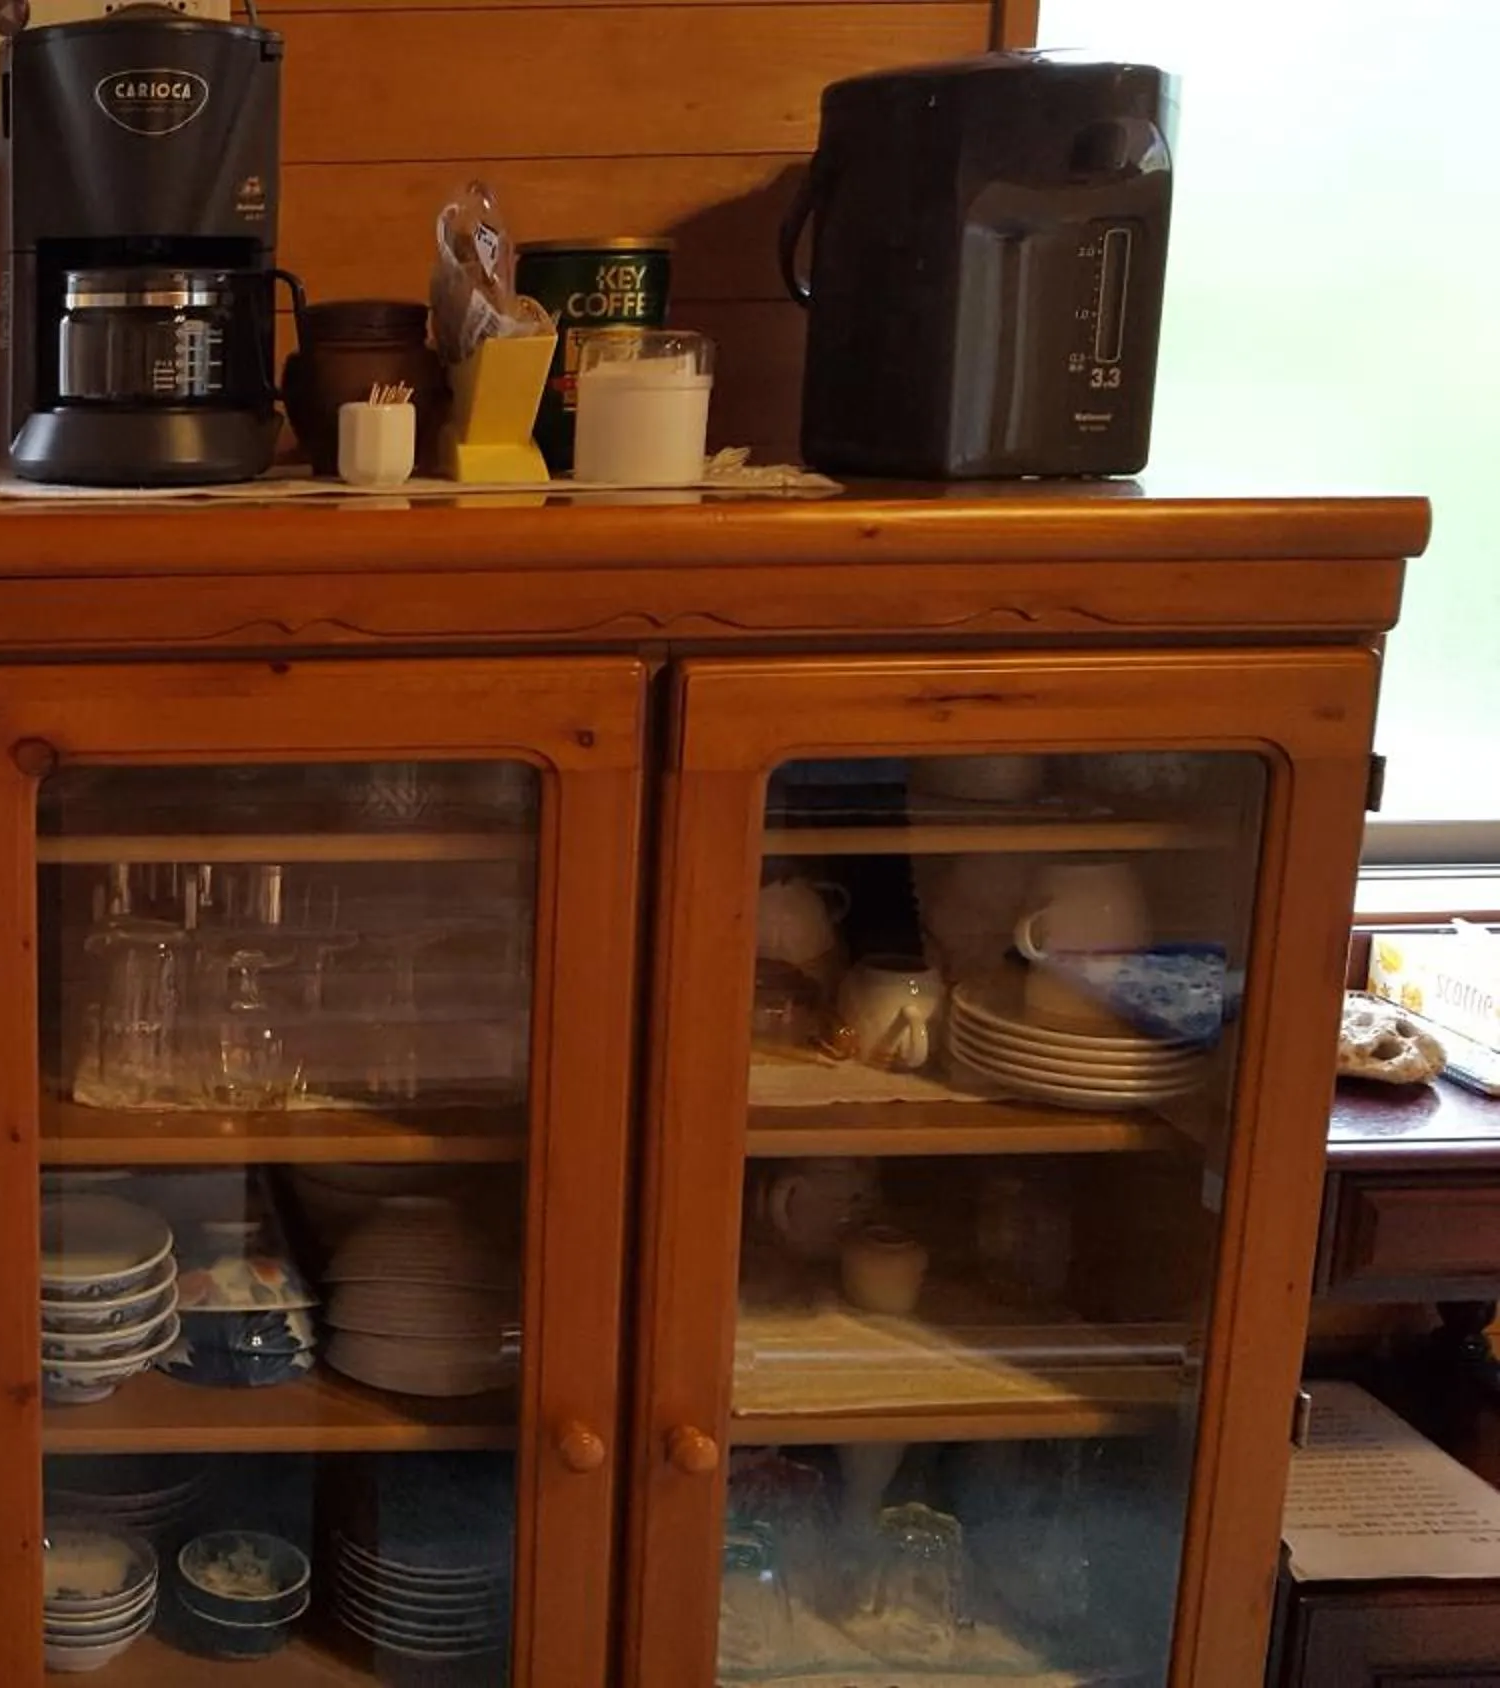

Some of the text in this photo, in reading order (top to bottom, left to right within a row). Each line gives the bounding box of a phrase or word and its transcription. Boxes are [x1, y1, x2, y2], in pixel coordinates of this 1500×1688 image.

[114, 81, 192, 99] CARIOCA
[596, 265, 648, 290] KEY
[1090, 366, 1122, 389] 3.3
